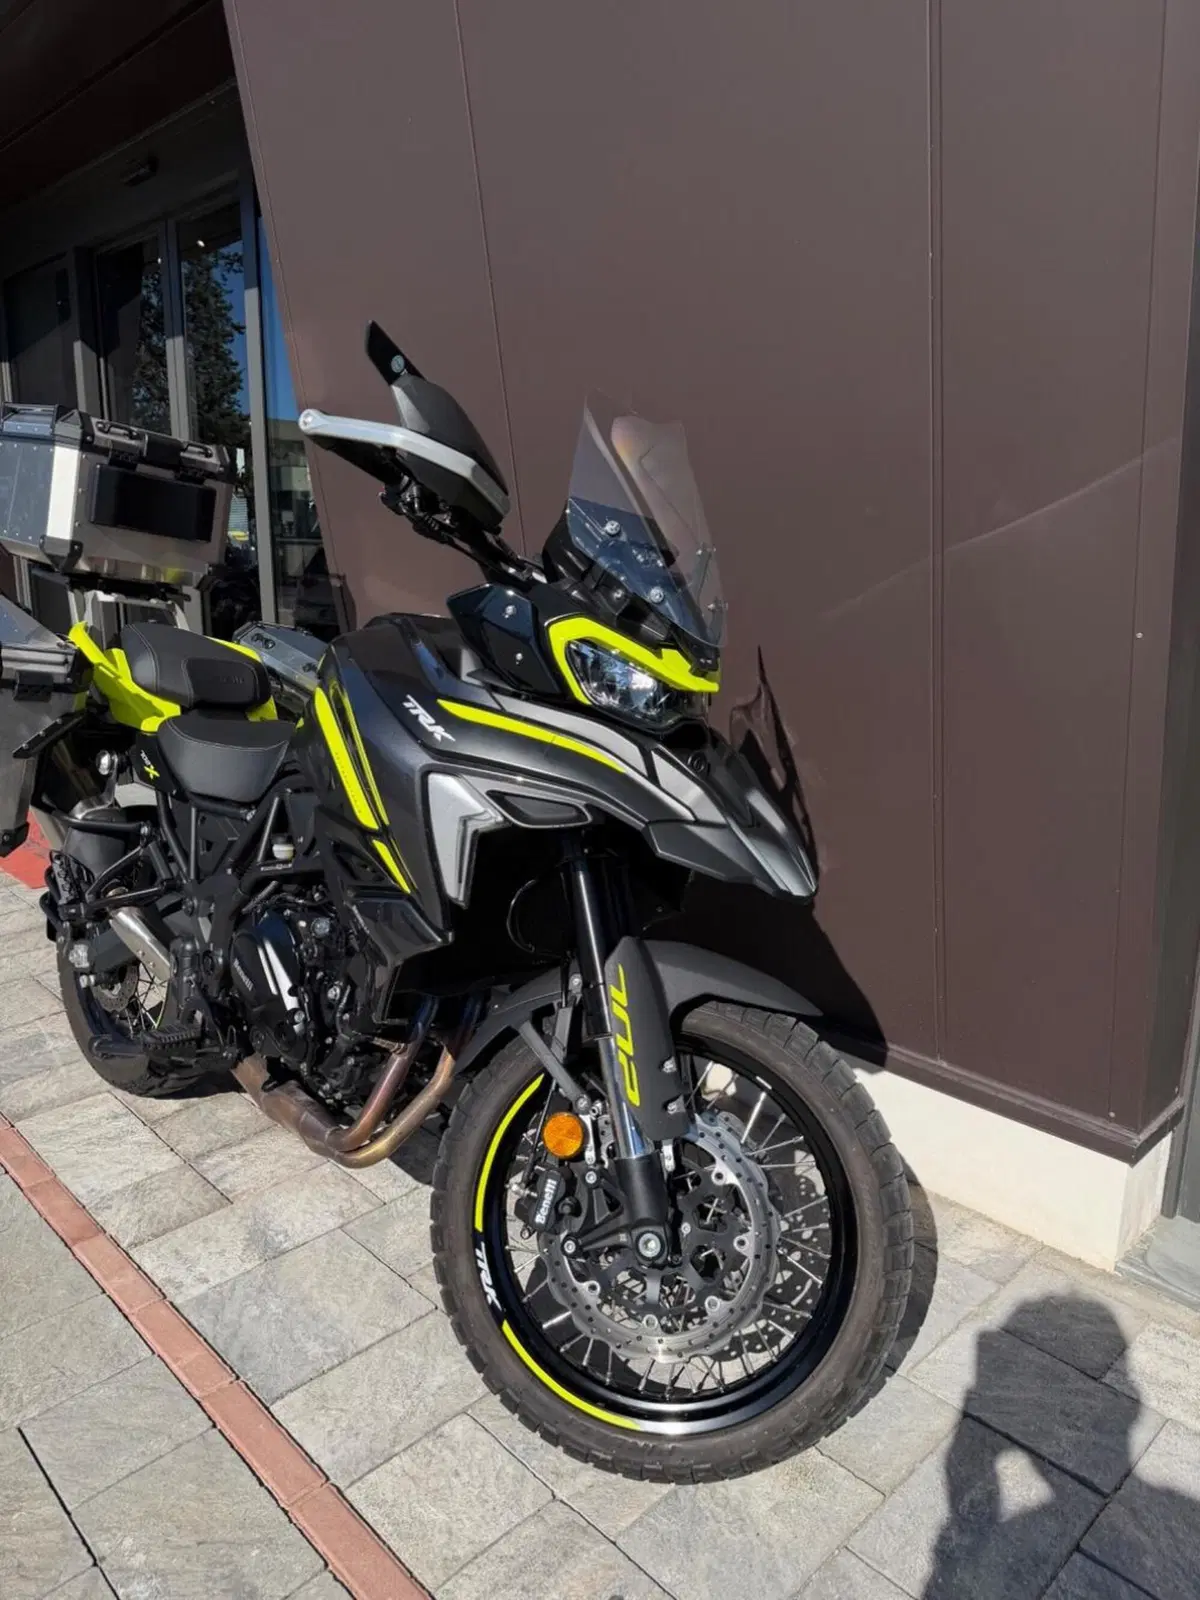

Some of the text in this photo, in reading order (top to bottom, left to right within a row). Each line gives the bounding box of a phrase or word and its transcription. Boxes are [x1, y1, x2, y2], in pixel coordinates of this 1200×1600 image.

[402, 694, 456, 742] TRK
[534, 1178, 557, 1225] Benelli
[475, 1241, 503, 1312] TRK
